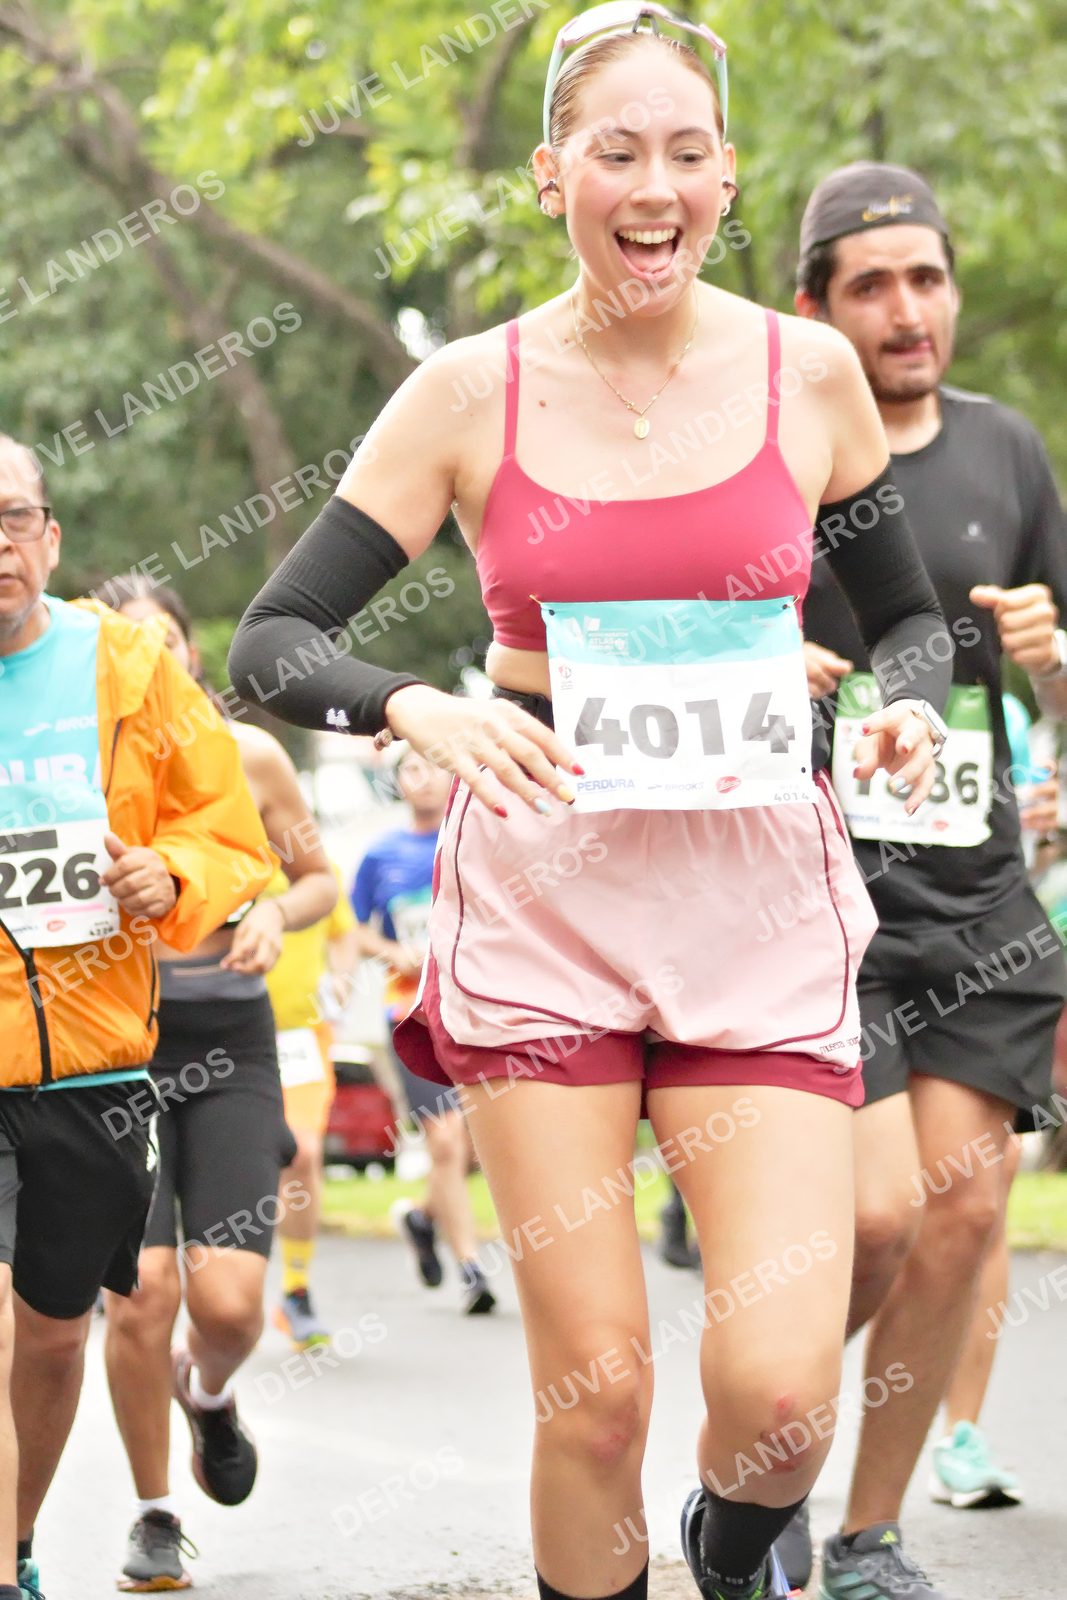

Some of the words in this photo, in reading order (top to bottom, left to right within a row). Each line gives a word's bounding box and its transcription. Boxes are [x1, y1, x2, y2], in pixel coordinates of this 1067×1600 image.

[574, 691, 795, 759] 4014
[576, 778, 635, 792] PERDURA
[773, 792, 809, 802] 4014
